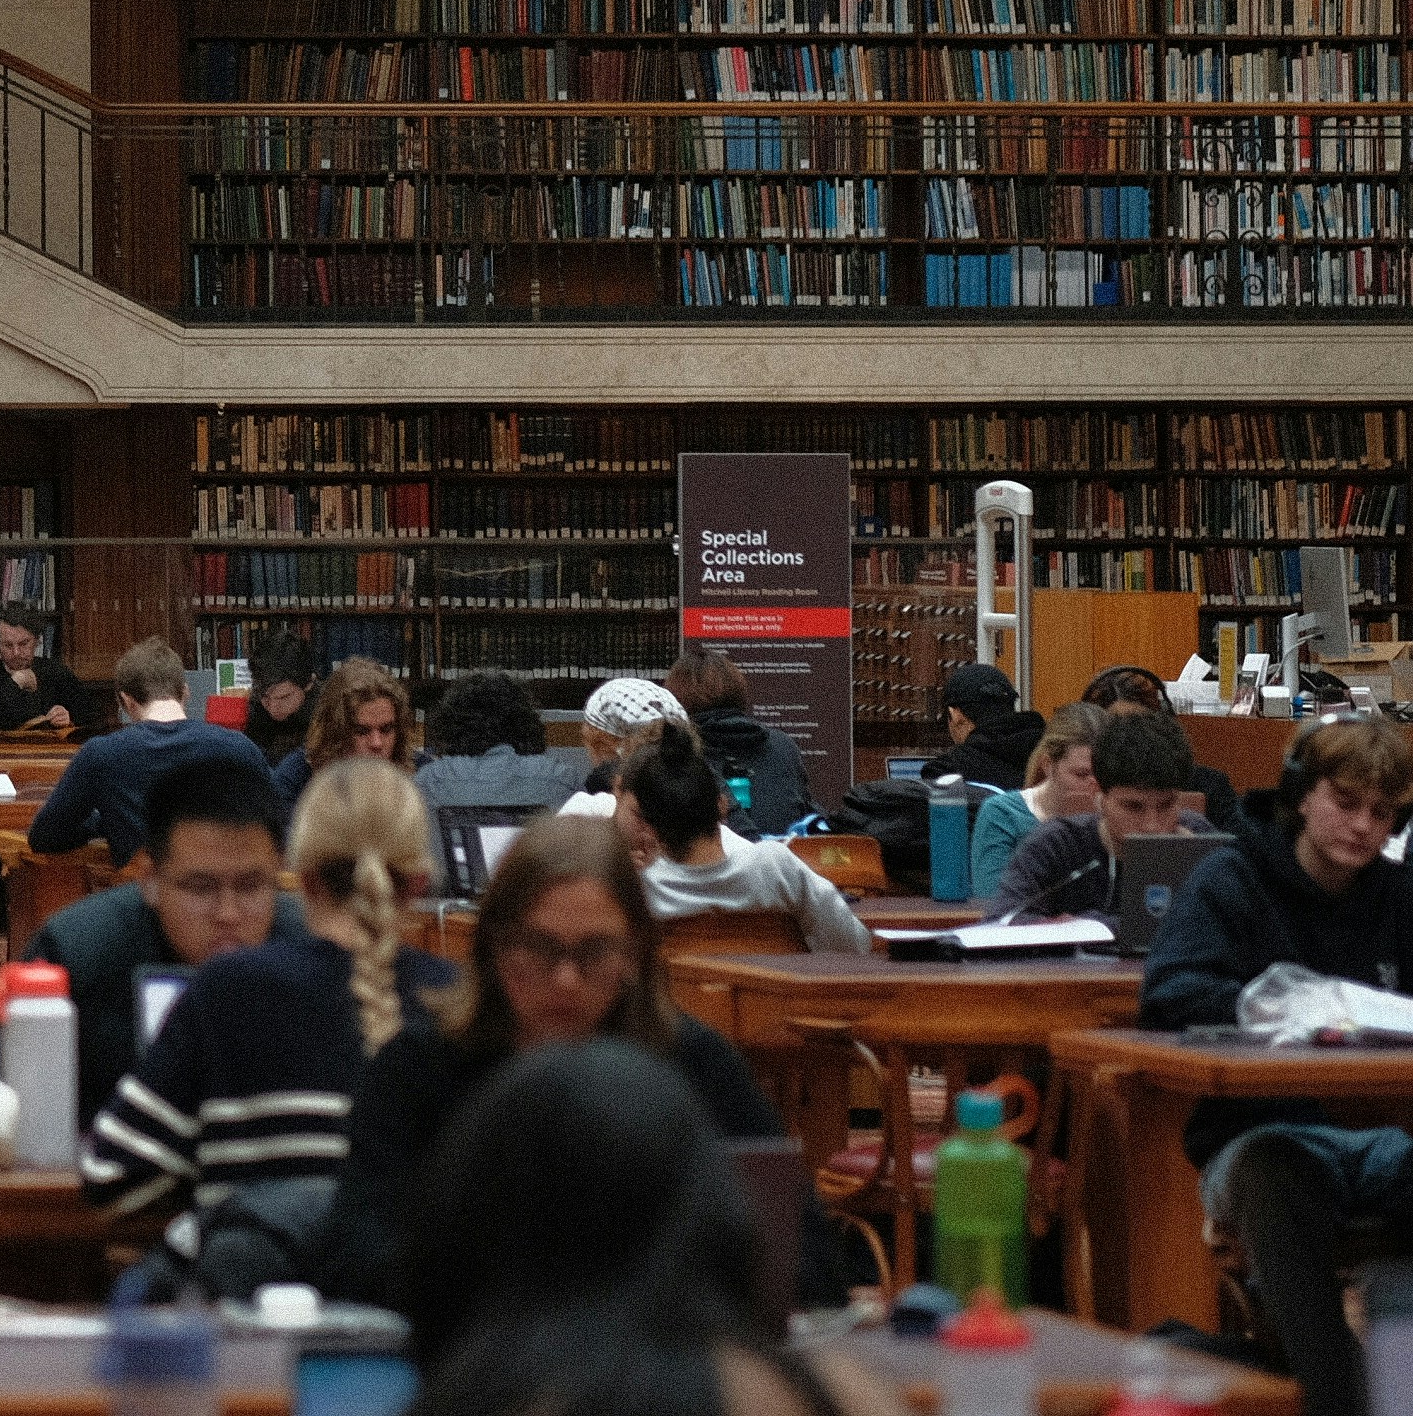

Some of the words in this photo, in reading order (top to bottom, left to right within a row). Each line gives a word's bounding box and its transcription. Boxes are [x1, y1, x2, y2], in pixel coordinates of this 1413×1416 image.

[701, 529, 768, 548] Special
[701, 549, 804, 565] Collections
[701, 567, 745, 583] Area
